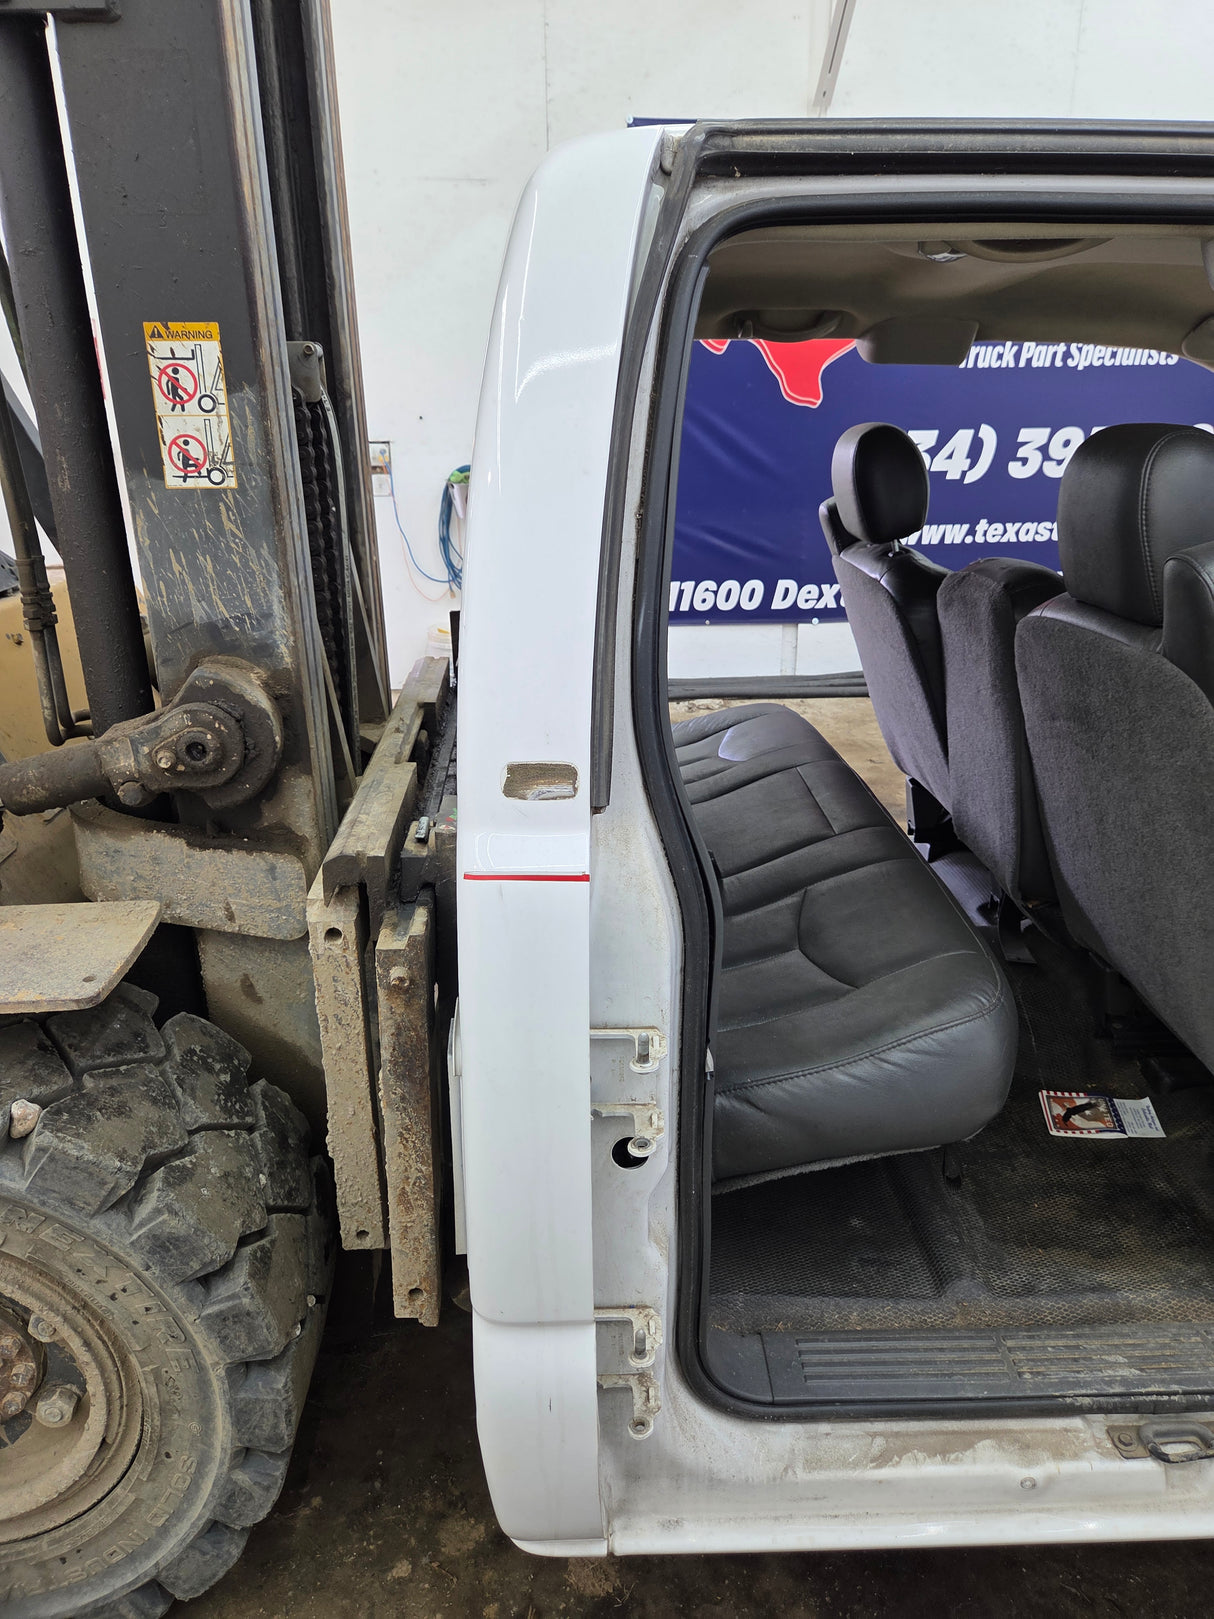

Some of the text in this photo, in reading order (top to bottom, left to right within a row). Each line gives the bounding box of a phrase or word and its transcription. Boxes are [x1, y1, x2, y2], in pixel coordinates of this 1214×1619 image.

[165, 330, 213, 340] WARNING
[1018, 342, 1067, 368] Part
[1008, 426, 1108, 479] 39
[669, 579, 846, 611] 11600 Dex
